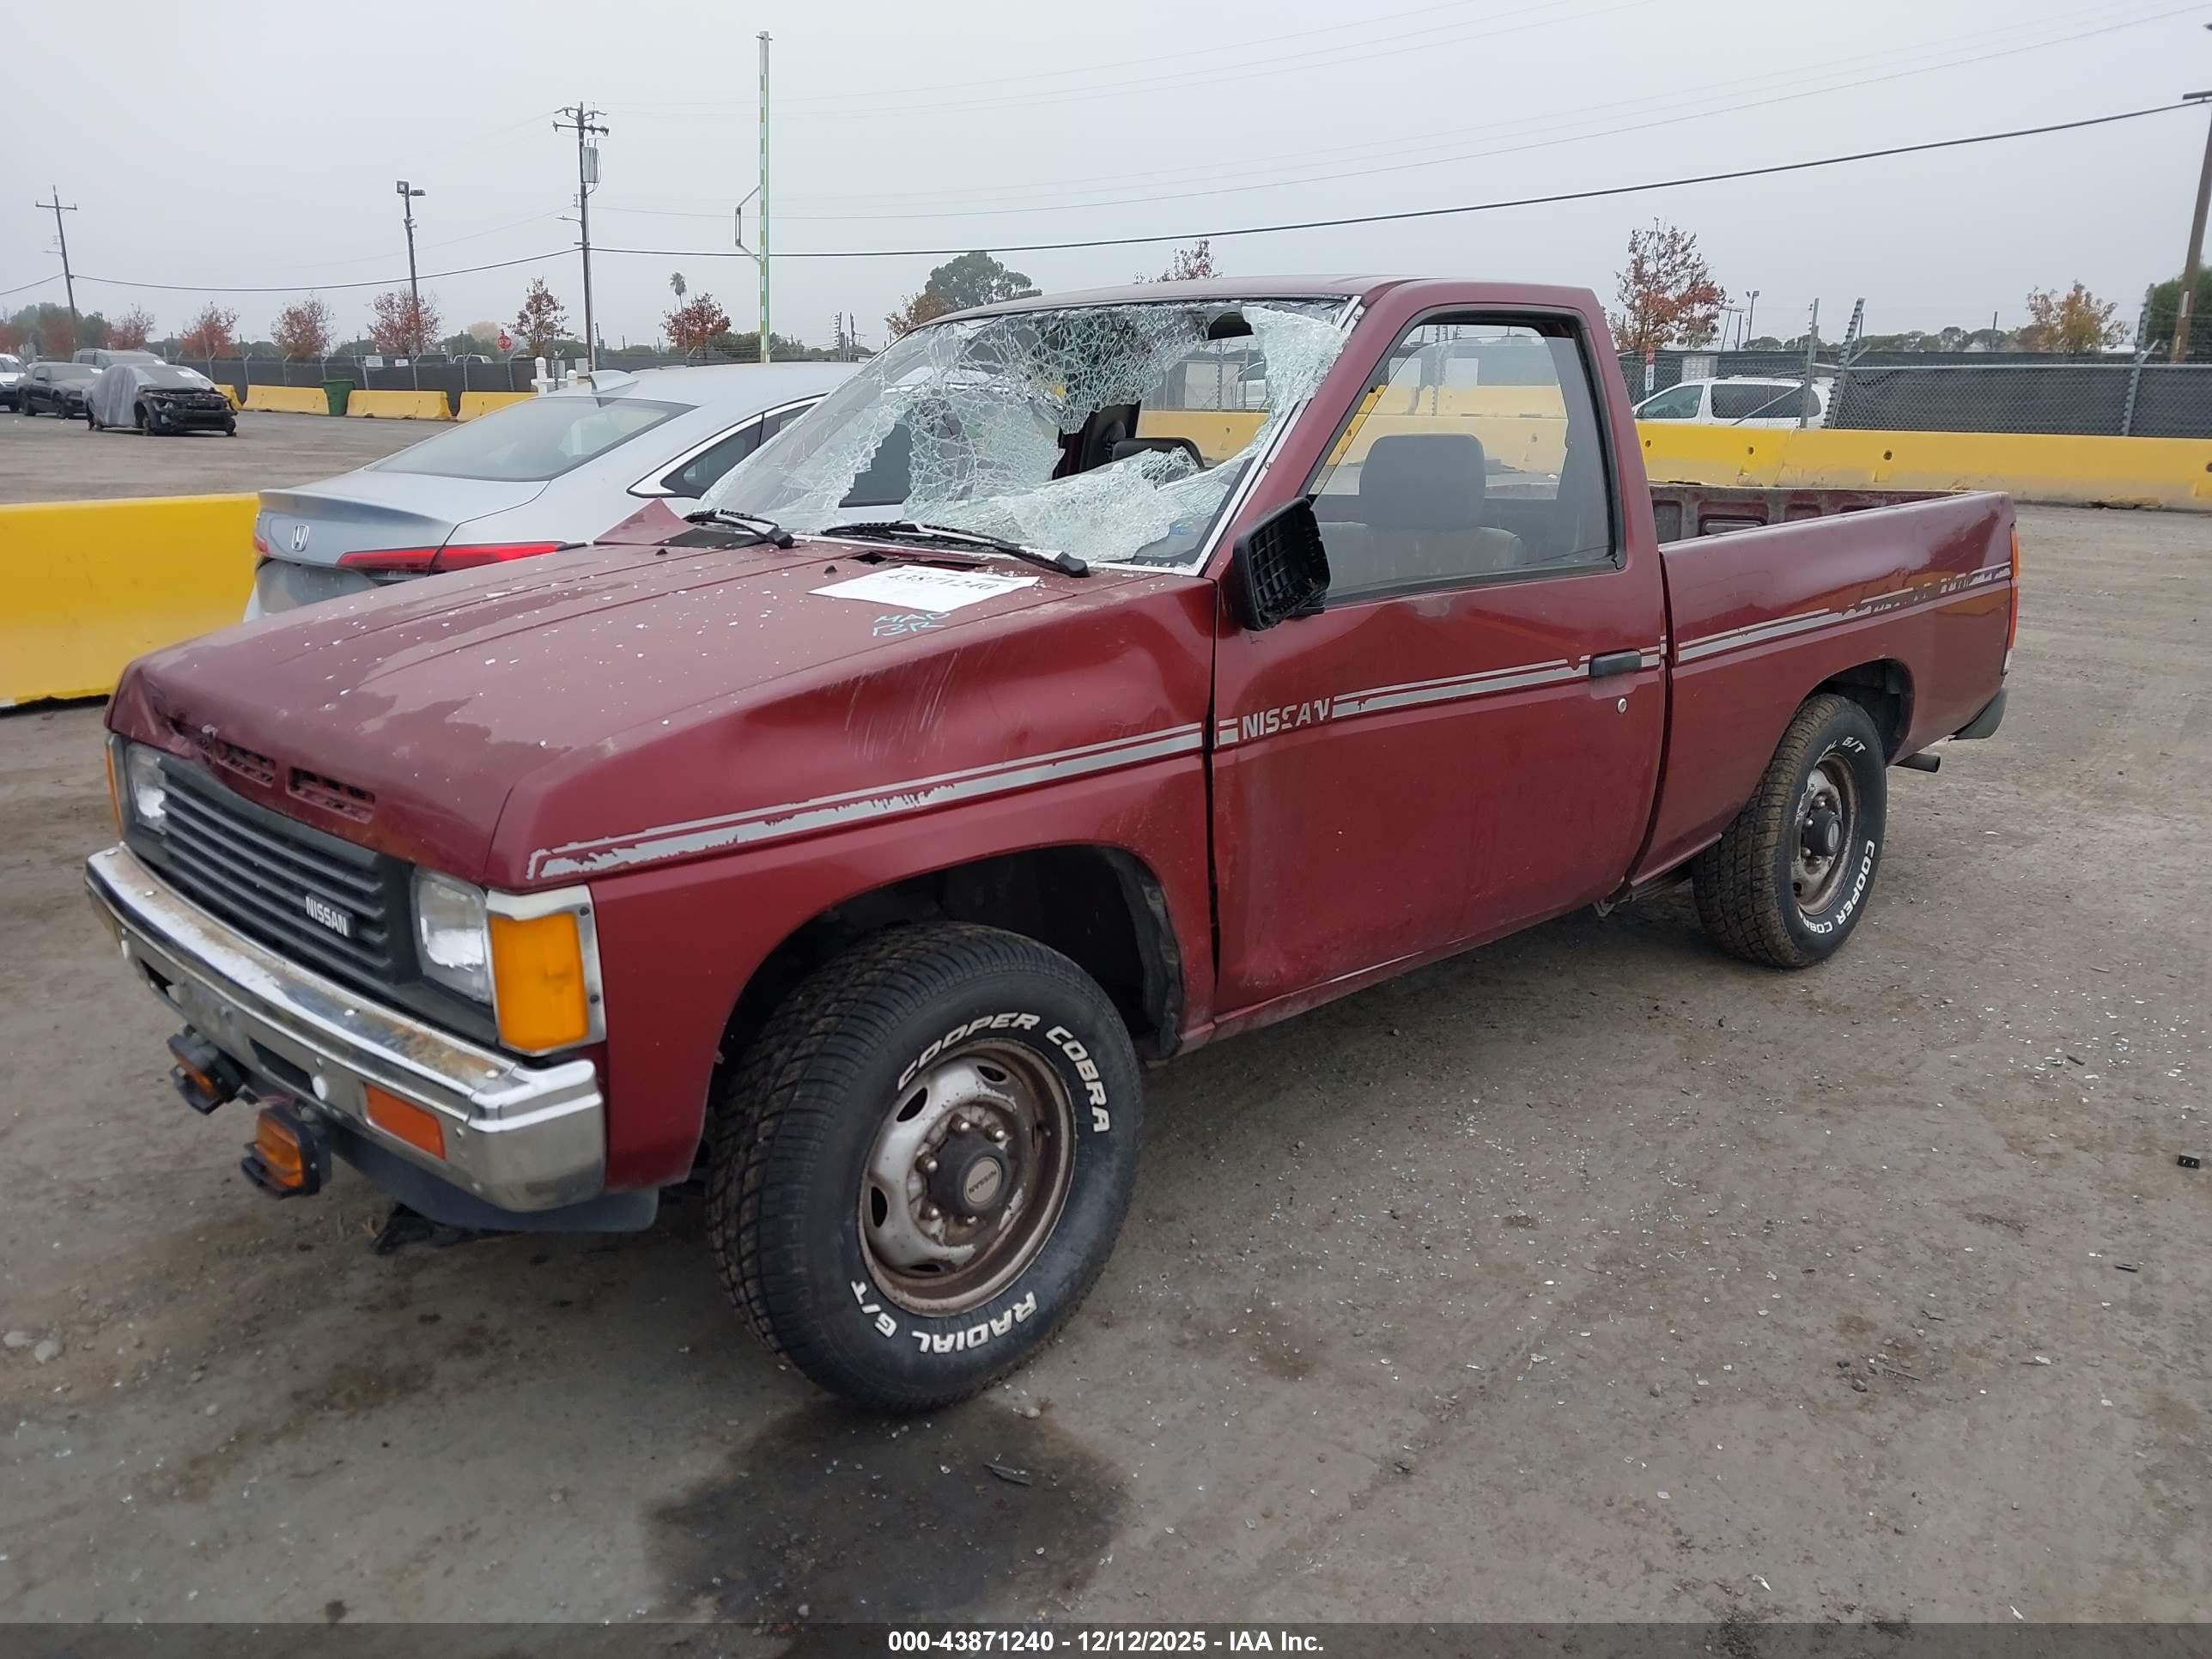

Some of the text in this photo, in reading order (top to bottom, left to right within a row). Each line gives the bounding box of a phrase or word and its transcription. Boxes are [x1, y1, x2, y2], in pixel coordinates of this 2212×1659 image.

[1842, 736, 1867, 753] G/T
[306, 896, 348, 937] NISSAN
[1836, 840, 1875, 925] COOPER
[896, 1012, 1111, 1133] COOPER COBRA
[851, 1279, 1038, 1354] RADIAL G/T
